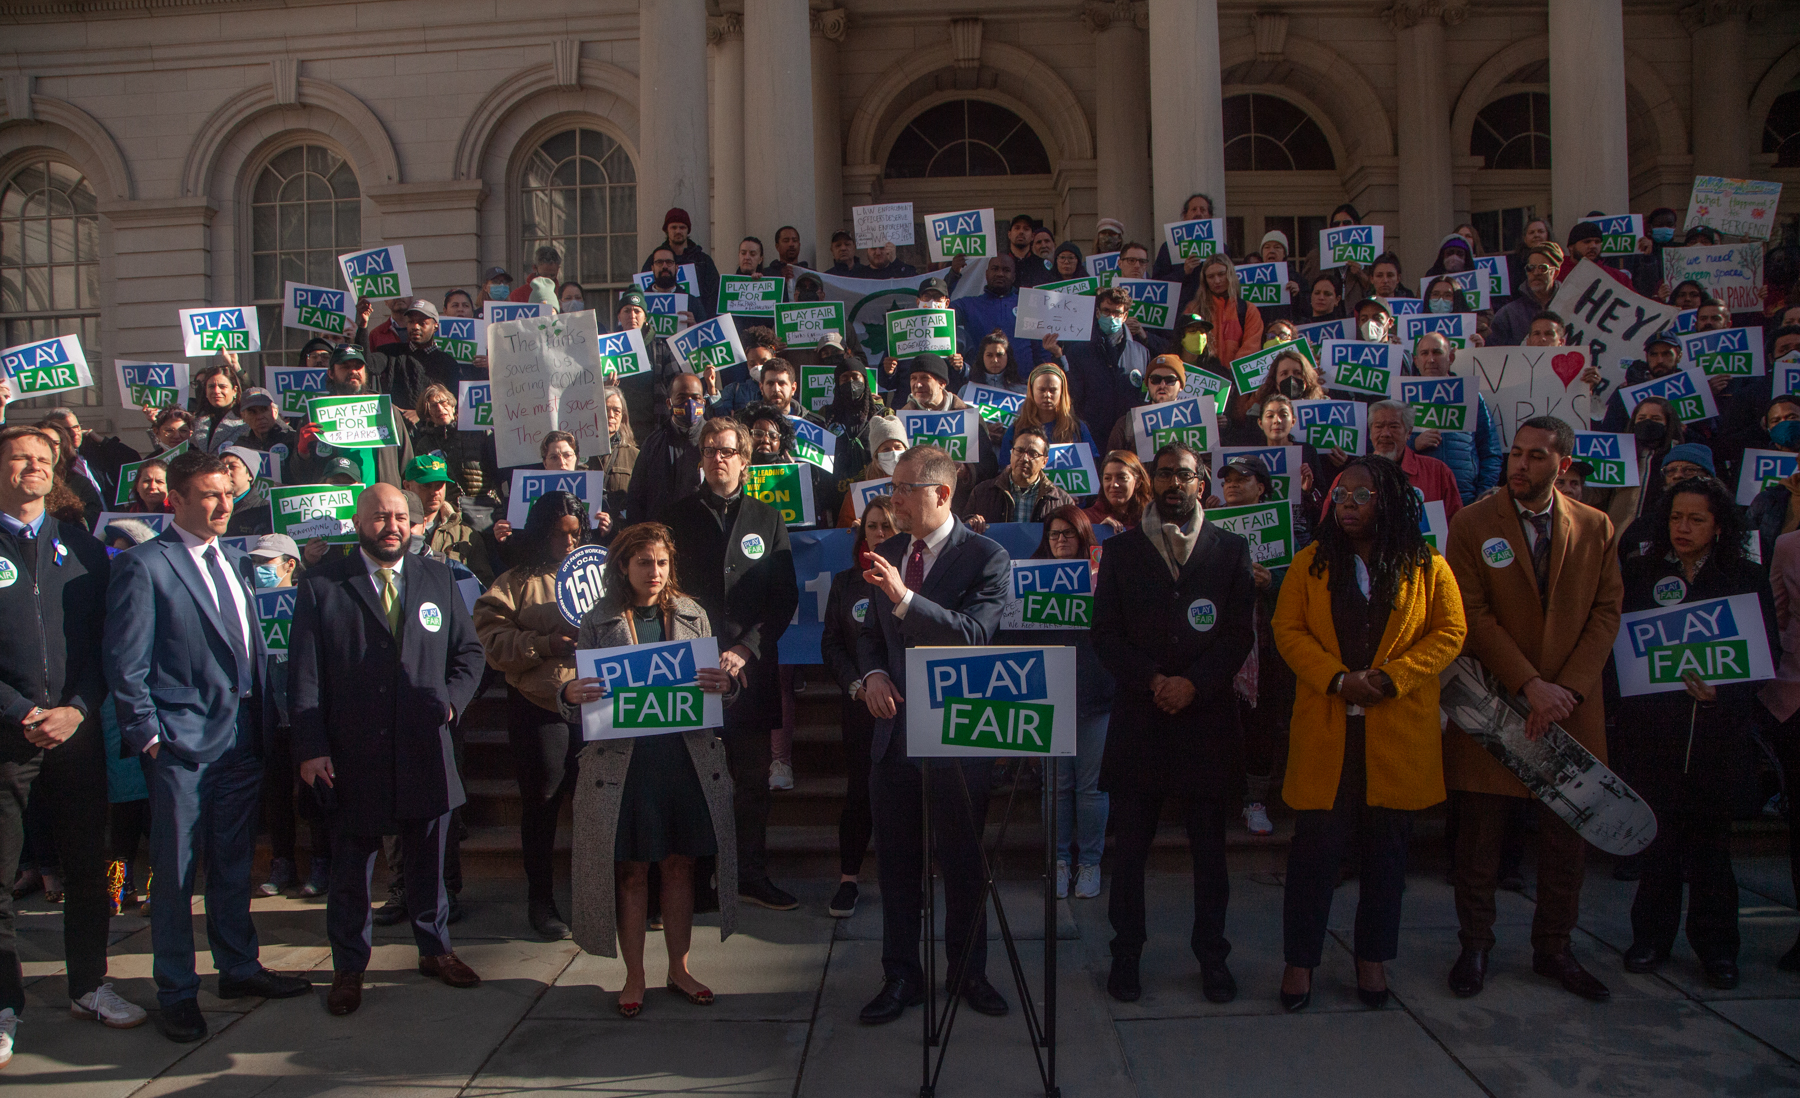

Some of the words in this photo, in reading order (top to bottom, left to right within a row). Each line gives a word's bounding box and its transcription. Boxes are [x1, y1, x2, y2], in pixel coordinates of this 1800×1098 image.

[1694, 194, 1722, 206] What
[934, 214, 977, 237] PLAY
[1599, 216, 1629, 235] LAY
[1689, 216, 1715, 228] ONE
[1173, 222, 1210, 243] PLAY
[1329, 228, 1369, 247] PLAY
[943, 238, 983, 254] FAIR
[1180, 242, 1213, 258] FAIR
[1334, 246, 1371, 261] FAIR
[1603, 237, 1632, 252] AIR
[346, 252, 386, 280] PLAY
[1686, 255, 1701, 265] we
[1706, 250, 1733, 264] need
[354, 276, 398, 296] FAIR
[727, 282, 750, 292] PLAY
[752, 282, 773, 291] FAIR
[1066, 282, 1088, 295] FAIR
[1241, 285, 1277, 301] FAIR
[296, 290, 342, 310] PLAY
[740, 292, 760, 301] FOR
[1043, 295, 1078, 313] Parks
[1727, 286, 1759, 309] PARKS
[193, 311, 239, 332] PLAY
[300, 308, 341, 332] FAIR
[783, 311, 809, 322] PLAY
[811, 307, 834, 318] FAIR
[893, 319, 918, 332] PLAY
[921, 315, 945, 327] FAIR
[438, 320, 472, 338] LAY
[650, 316, 674, 333] AIR
[799, 320, 821, 330] FOR
[908, 328, 932, 339] FOR
[1036, 320, 1084, 336] Equity
[1409, 318, 1458, 338] PLAY
[202, 333, 246, 349] FAIR
[503, 332, 539, 354] The
[677, 324, 720, 354] PLAY
[1689, 331, 1742, 359] PLAY
[4, 342, 60, 375] PLAY
[689, 346, 732, 372] FAIR
[1241, 356, 1268, 374] PLAY
[1334, 347, 1385, 364] PLAY
[1699, 355, 1748, 374] FAIR
[503, 356, 540, 379] saved
[553, 356, 573, 369] us
[603, 357, 636, 375] AIR
[19, 368, 76, 390] FAIR
[125, 367, 170, 385] PLAY
[277, 372, 325, 391] PLAY
[1193, 375, 1218, 391] FAIR
[1338, 366, 1384, 391] FAIR
[132, 387, 173, 407] FAIR
[505, 379, 545, 398] during
[1183, 386, 1200, 396] OR
[1404, 381, 1459, 404] PLAY
[505, 403, 527, 421] We
[532, 396, 559, 416] must
[565, 399, 599, 414] save
[976, 390, 1025, 412] PLAY
[318, 406, 348, 421] PLAY
[351, 401, 379, 415] FAIR
[1146, 402, 1193, 432] PLAY
[1301, 405, 1350, 426] PLAY
[338, 418, 365, 429] FOR
[909, 414, 961, 436] PLAY
[1491, 394, 1588, 448] ARKS
[329, 431, 343, 442] 1%
[346, 429, 377, 440] PARKS
[510, 426, 543, 446] The
[796, 423, 820, 441] AY
[1309, 426, 1354, 450] FAIR
[794, 438, 820, 462] AIR
[1576, 437, 1613, 457] LAY
[757, 468, 785, 477] LEADING
[1053, 471, 1085, 491] AIR
[281, 496, 315, 512] PLAY
[319, 493, 351, 507] FAIR
[303, 508, 333, 521] FOR
[1242, 512, 1276, 530] FAIR
[743, 537, 760, 548] PLAY
[747, 545, 763, 554] FAIR
[1485, 541, 1505, 557] PLAY
[572, 555, 599, 570] LOCAL
[1491, 550, 1512, 562] FAIR
[1017, 565, 1085, 594] PLAY
[1657, 581, 1679, 593] PLAY
[1659, 591, 1682, 600] FAIR
[259, 593, 297, 619] LAY
[422, 608, 438, 618] PLAY
[1027, 595, 1089, 623] FAIR
[1192, 605, 1211, 616] PLAY
[426, 616, 440, 626] FAIR
[1007, 619, 1019, 629] We
[1195, 615, 1213, 624] FAIR
[1634, 605, 1723, 652] PLAY
[601, 648, 686, 692] PLAY
[1654, 646, 1742, 679] FAIR
[934, 658, 1037, 702] PLAY
[619, 691, 697, 723] FAIR
[948, 703, 1043, 745] FAIR
